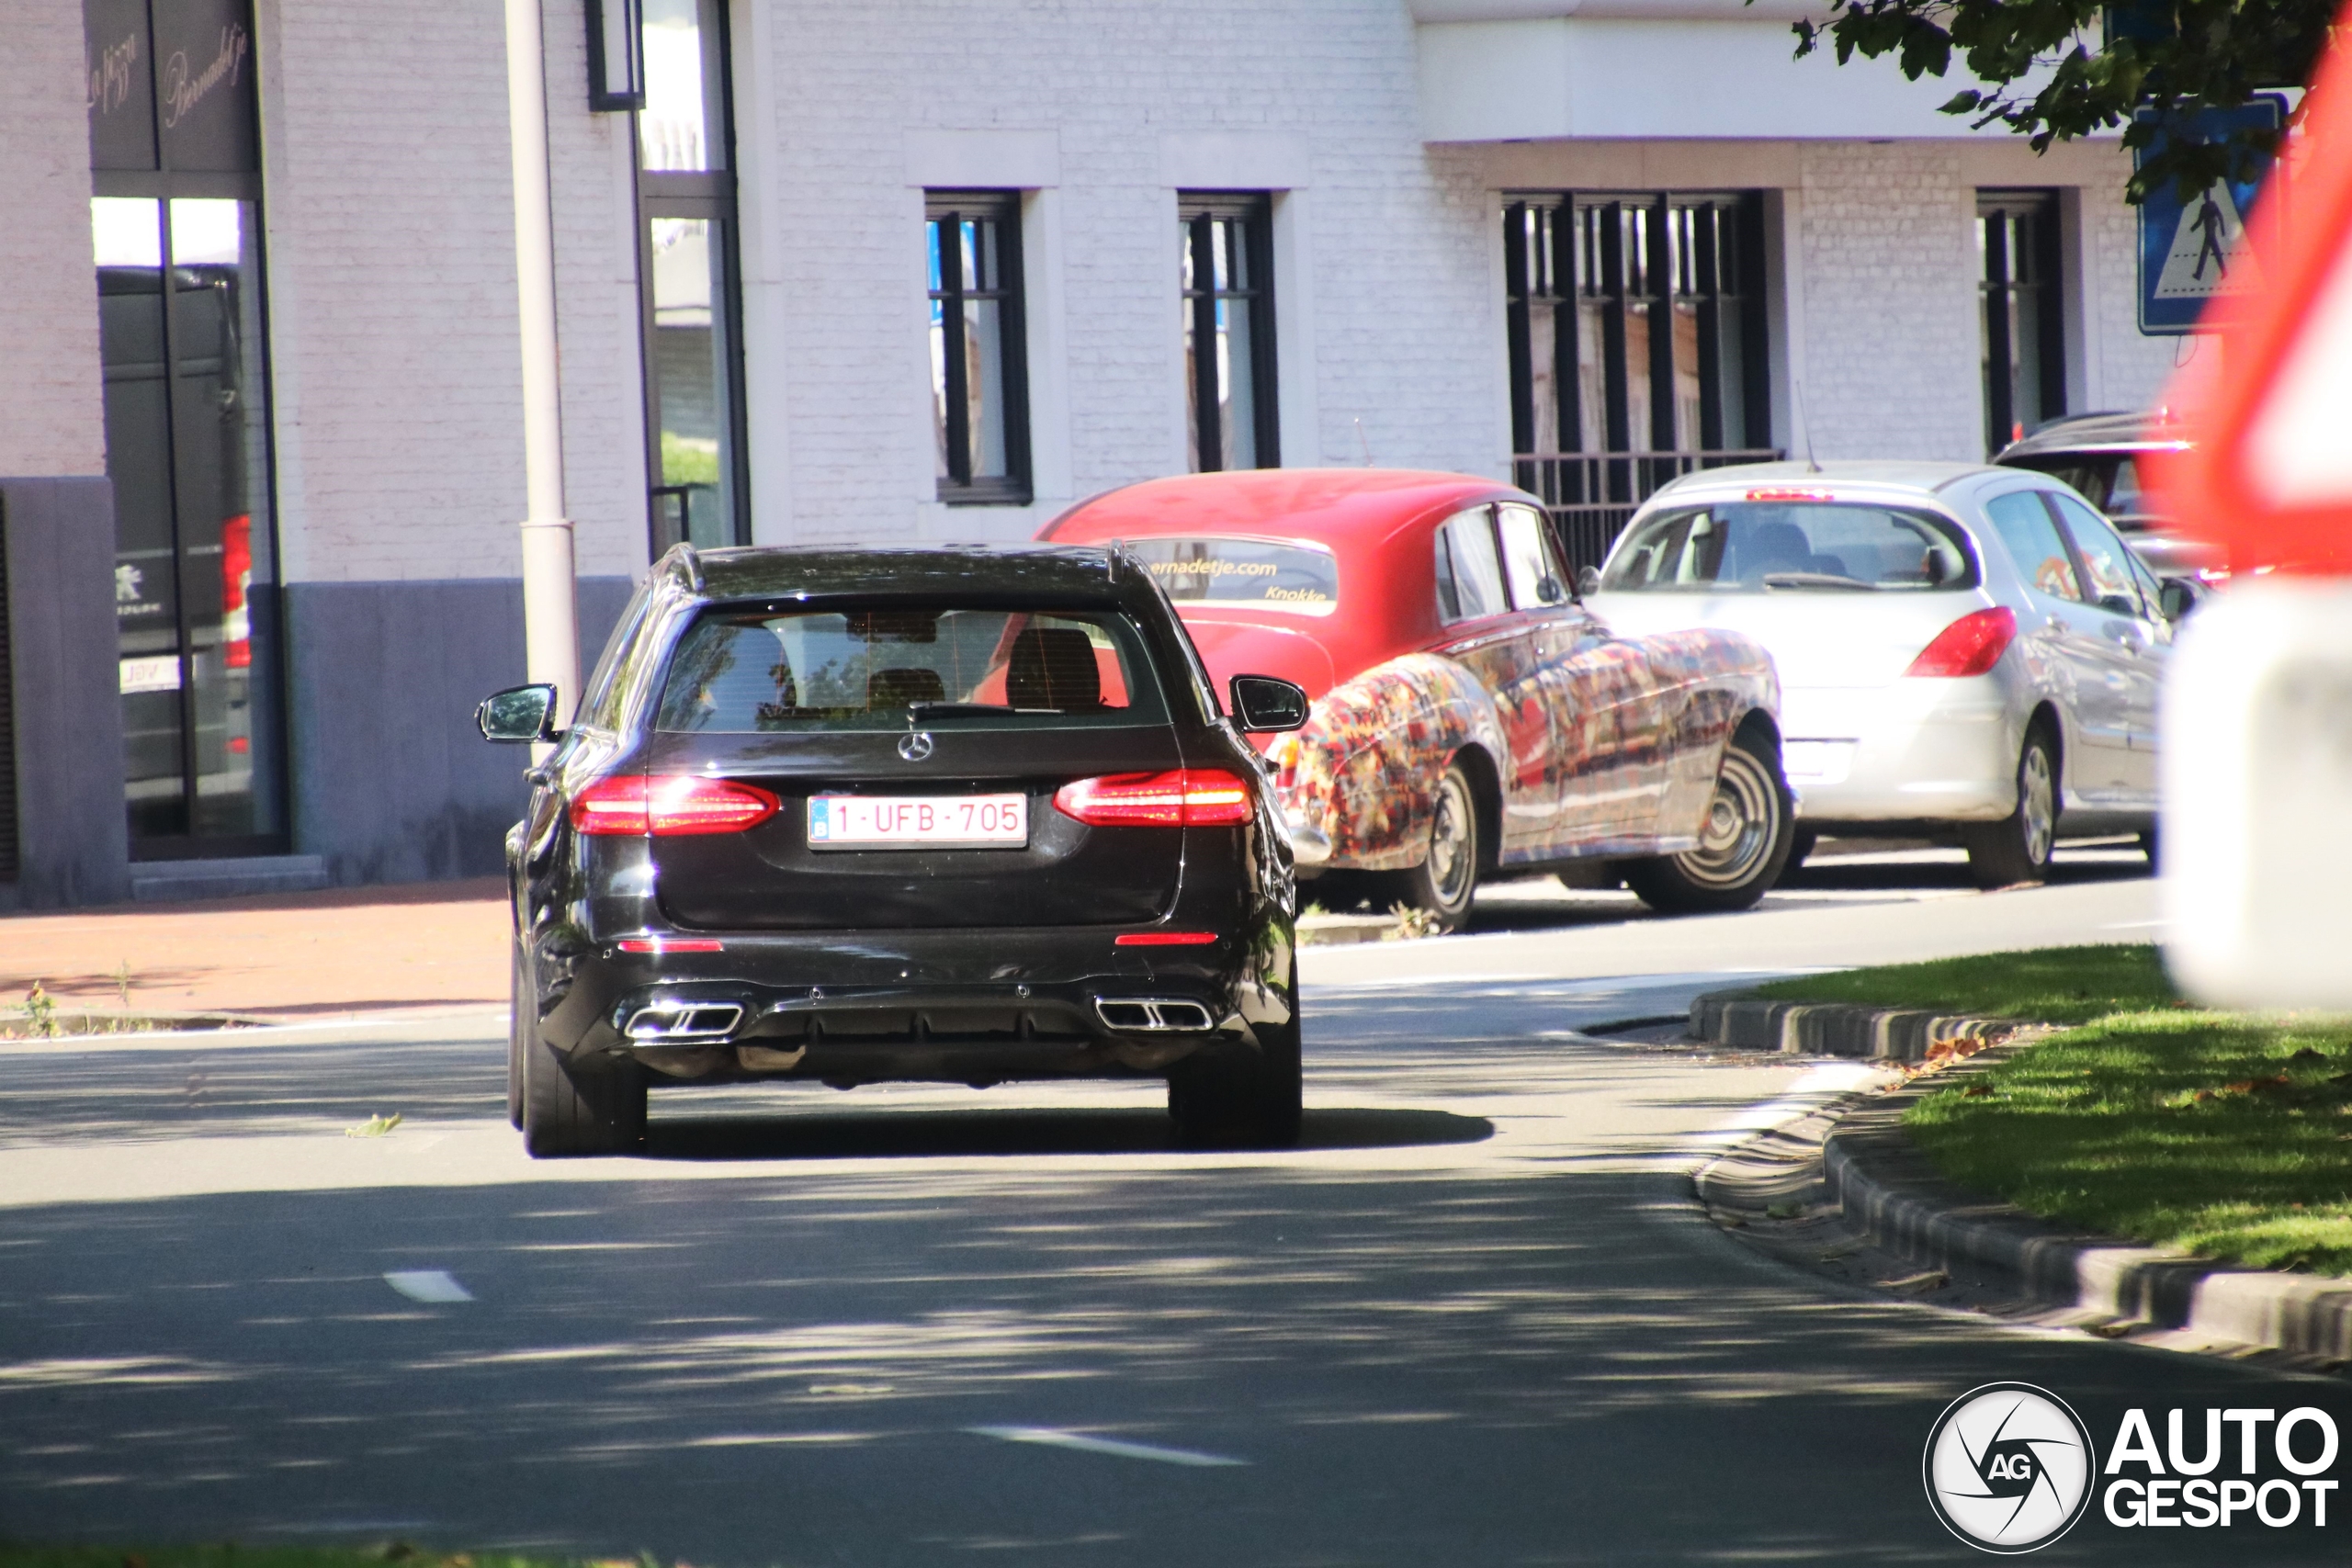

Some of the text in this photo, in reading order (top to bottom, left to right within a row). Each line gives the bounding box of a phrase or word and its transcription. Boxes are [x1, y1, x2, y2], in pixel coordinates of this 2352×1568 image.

[1150, 558, 1277, 578] ernadetje.com
[1265, 585, 1327, 603] Knokke
[837, 803, 1018, 832] 1-UFB-705
[814, 821, 828, 837] B
